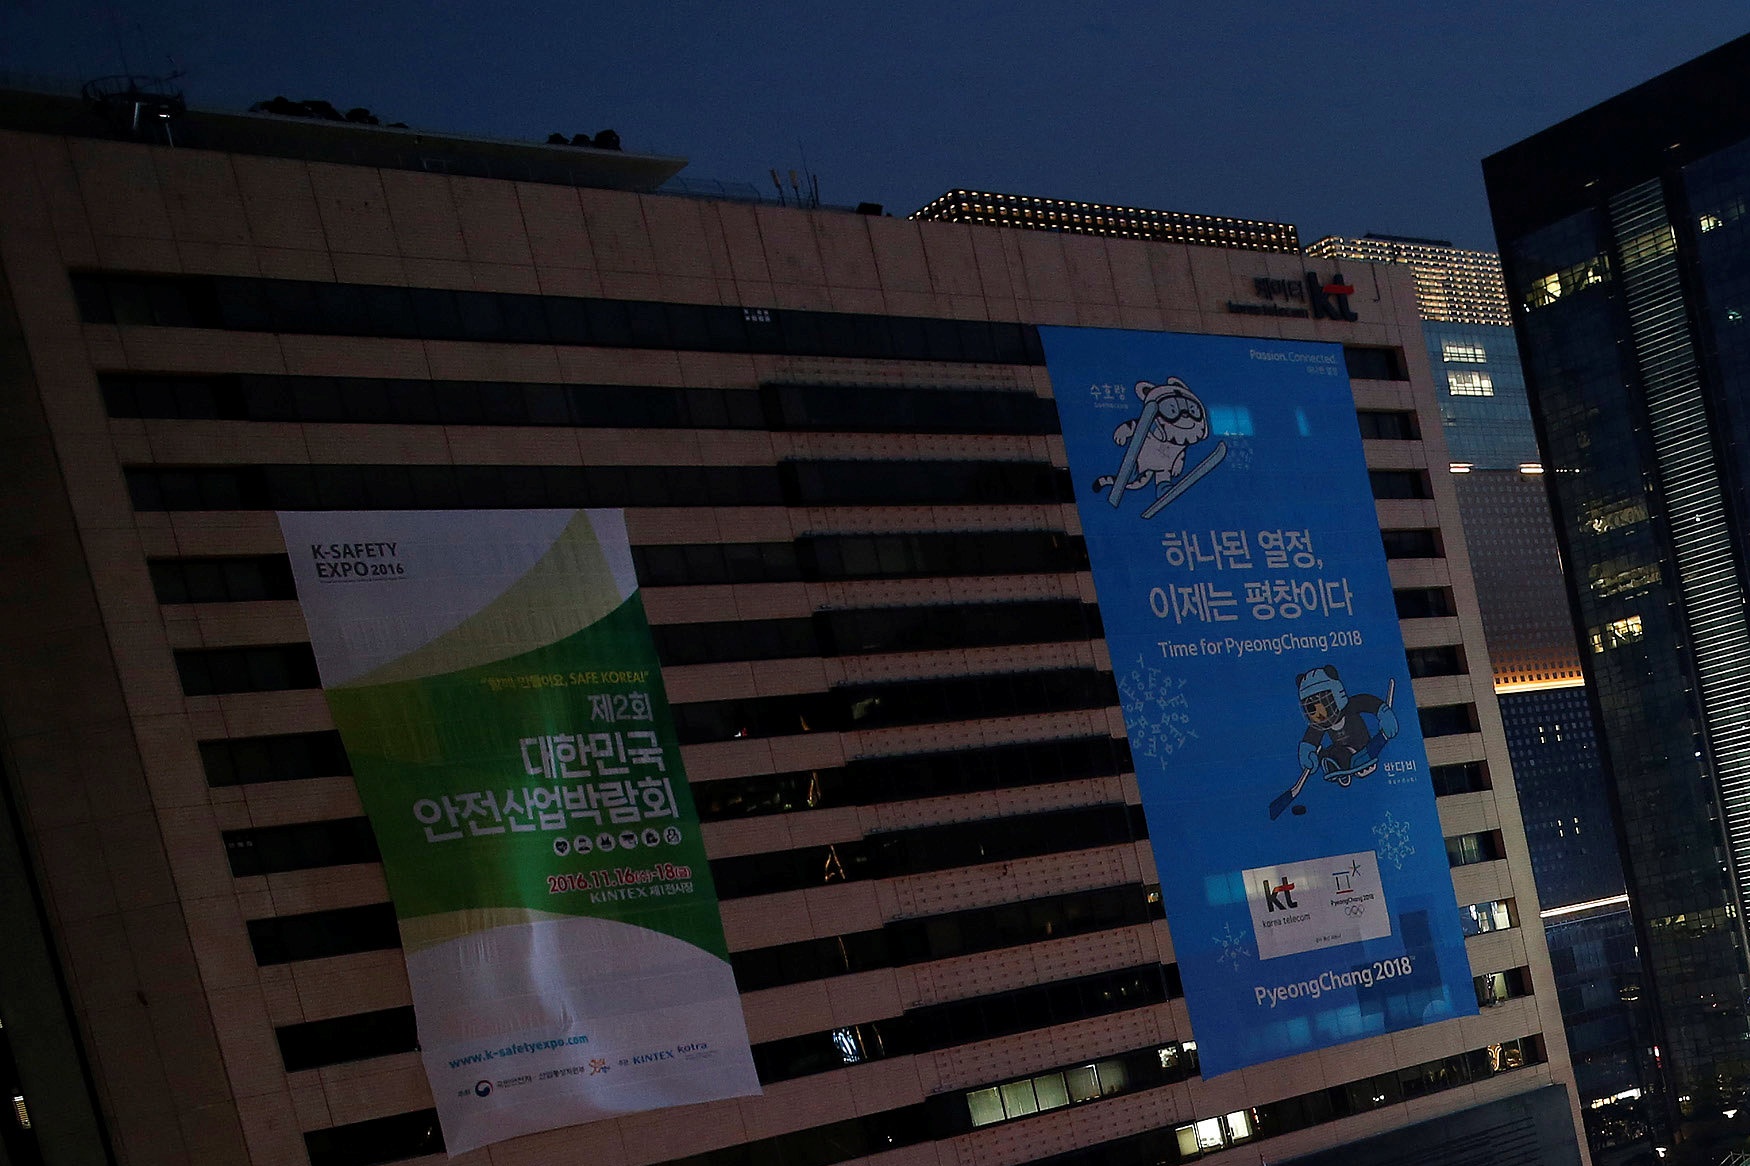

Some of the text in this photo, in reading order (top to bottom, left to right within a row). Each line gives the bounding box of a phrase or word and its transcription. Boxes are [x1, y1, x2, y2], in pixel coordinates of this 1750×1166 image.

[1306, 271, 1358, 322] kt
[1090, 383, 1126, 401] 수호랑
[311, 542, 397, 559] K-SAFETY
[1161, 529, 1324, 571] 하나된 열정,
[316, 561, 405, 578] EXPO 2016
[1150, 577, 1354, 625] 이제는 평창이다
[1157, 629, 1363, 658] Time for PyeongChang 2018
[588, 691, 654, 723] 제2회
[519, 730, 667, 779] 대한민국
[1383, 760, 1417, 777] 반다비
[413, 776, 680, 843] 안전산업박람회
[590, 887, 647, 904] KINTEX
[1263, 876, 1298, 913] kt
[1254, 956, 1413, 1008] PyeongChang 2018
[448, 1035, 589, 1069] www.k-safetyexpo.com
[633, 1050, 674, 1065] KINTEX
